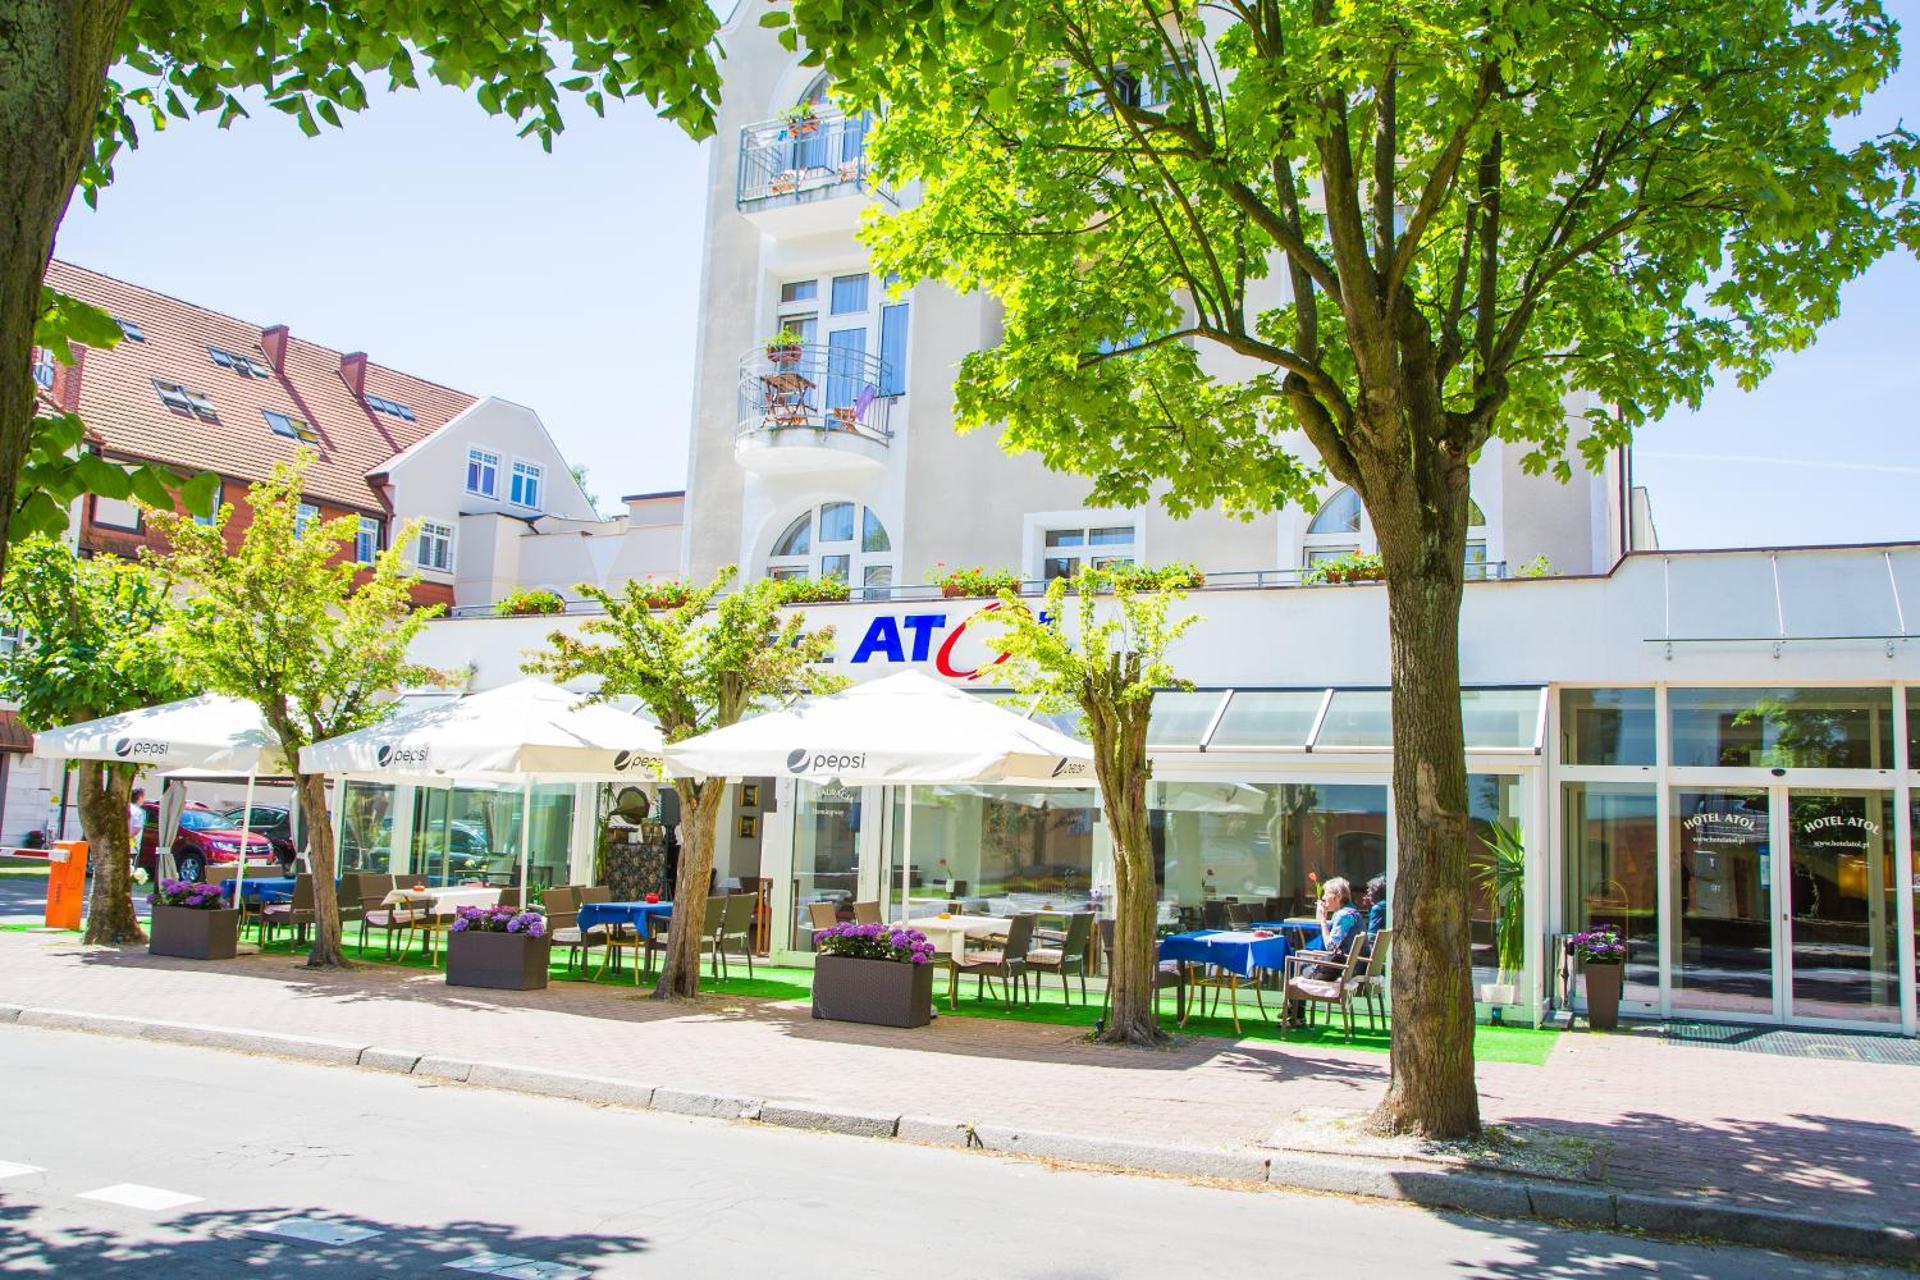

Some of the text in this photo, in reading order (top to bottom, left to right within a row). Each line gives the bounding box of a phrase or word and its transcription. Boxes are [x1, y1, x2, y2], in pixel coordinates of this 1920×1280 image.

[851, 602, 1071, 680] ATO
[133, 742, 169, 756] pepsi
[393, 747, 429, 764] pepsi
[631, 756, 663, 769] peps
[813, 752, 866, 771] pepsi
[1683, 813, 1755, 831] HOTEL ATOL
[1804, 816, 1880, 835] HOTEL ATOL
[1813, 840, 1870, 849] www.hotelatol.pl
